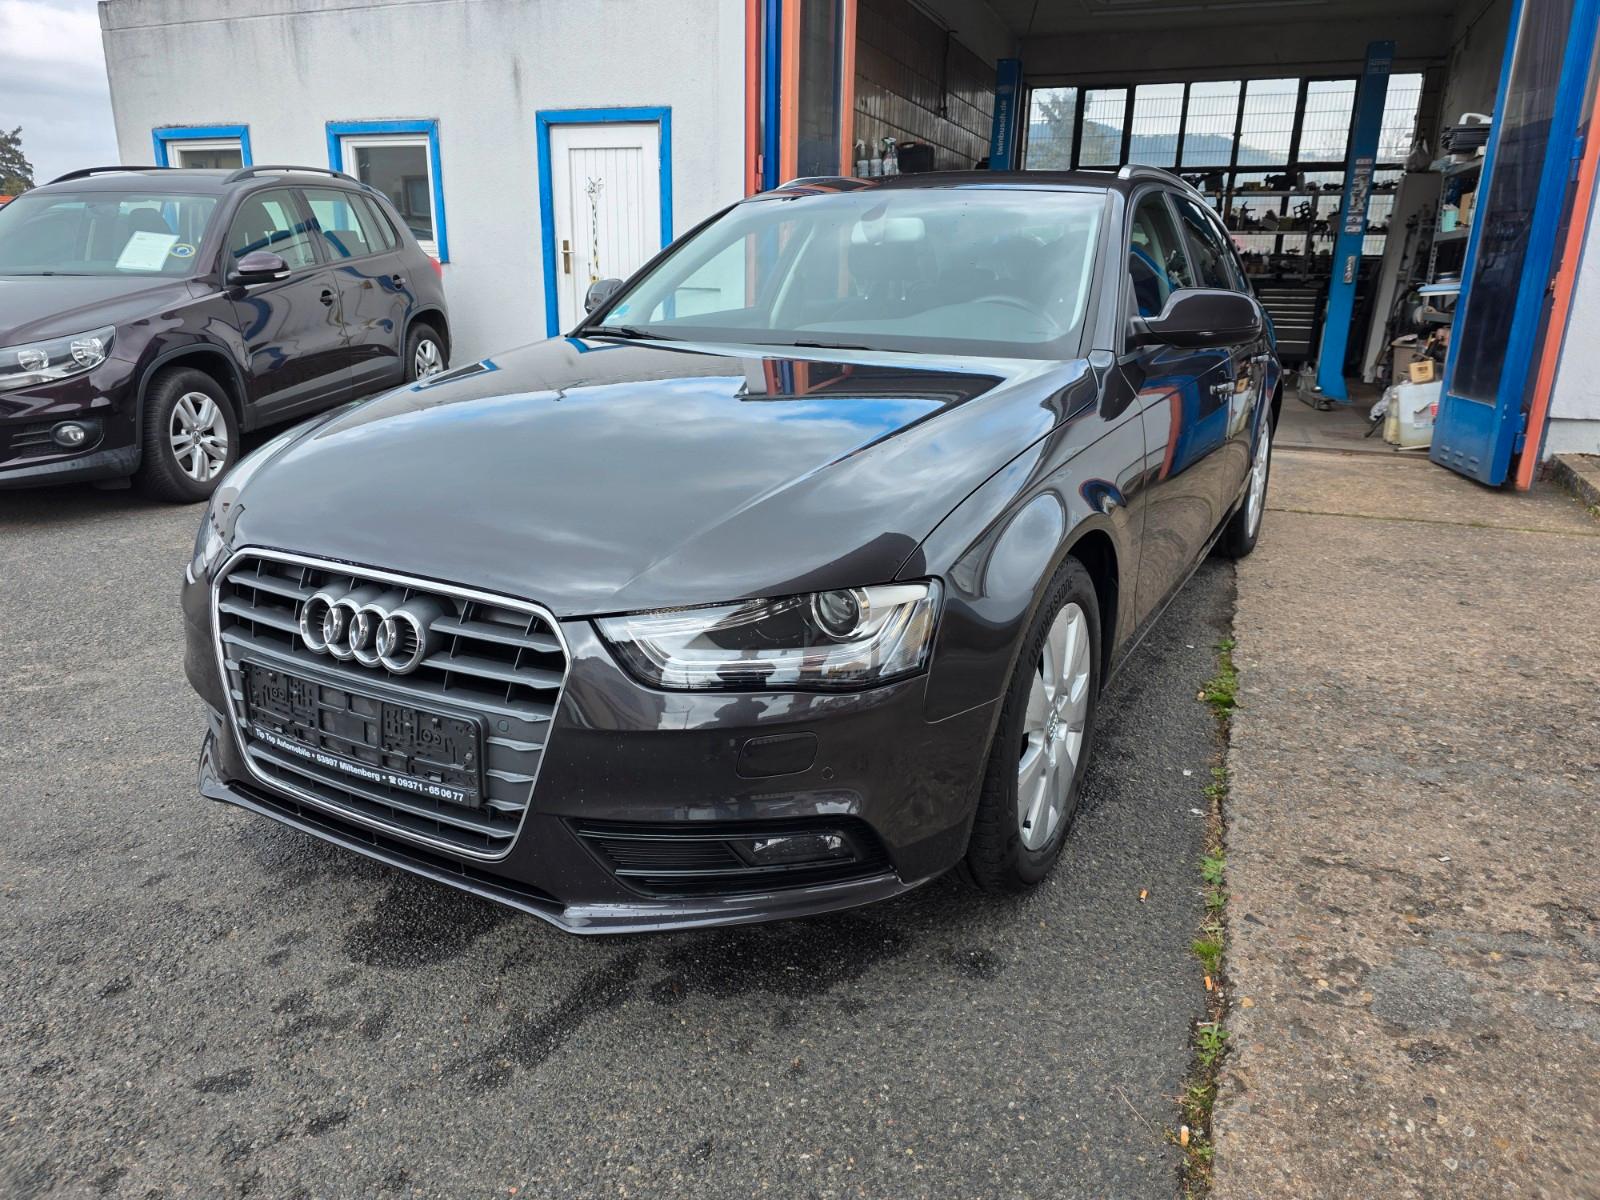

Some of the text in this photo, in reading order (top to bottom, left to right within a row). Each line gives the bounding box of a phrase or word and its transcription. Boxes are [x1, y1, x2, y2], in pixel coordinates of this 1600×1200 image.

[255, 728, 265, 739] Tip
[265, 733, 276, 744] Top
[277, 739, 311, 758] Automobile
[339, 761, 381, 782] Miltenberg
[398, 778, 423, 791] 09371
